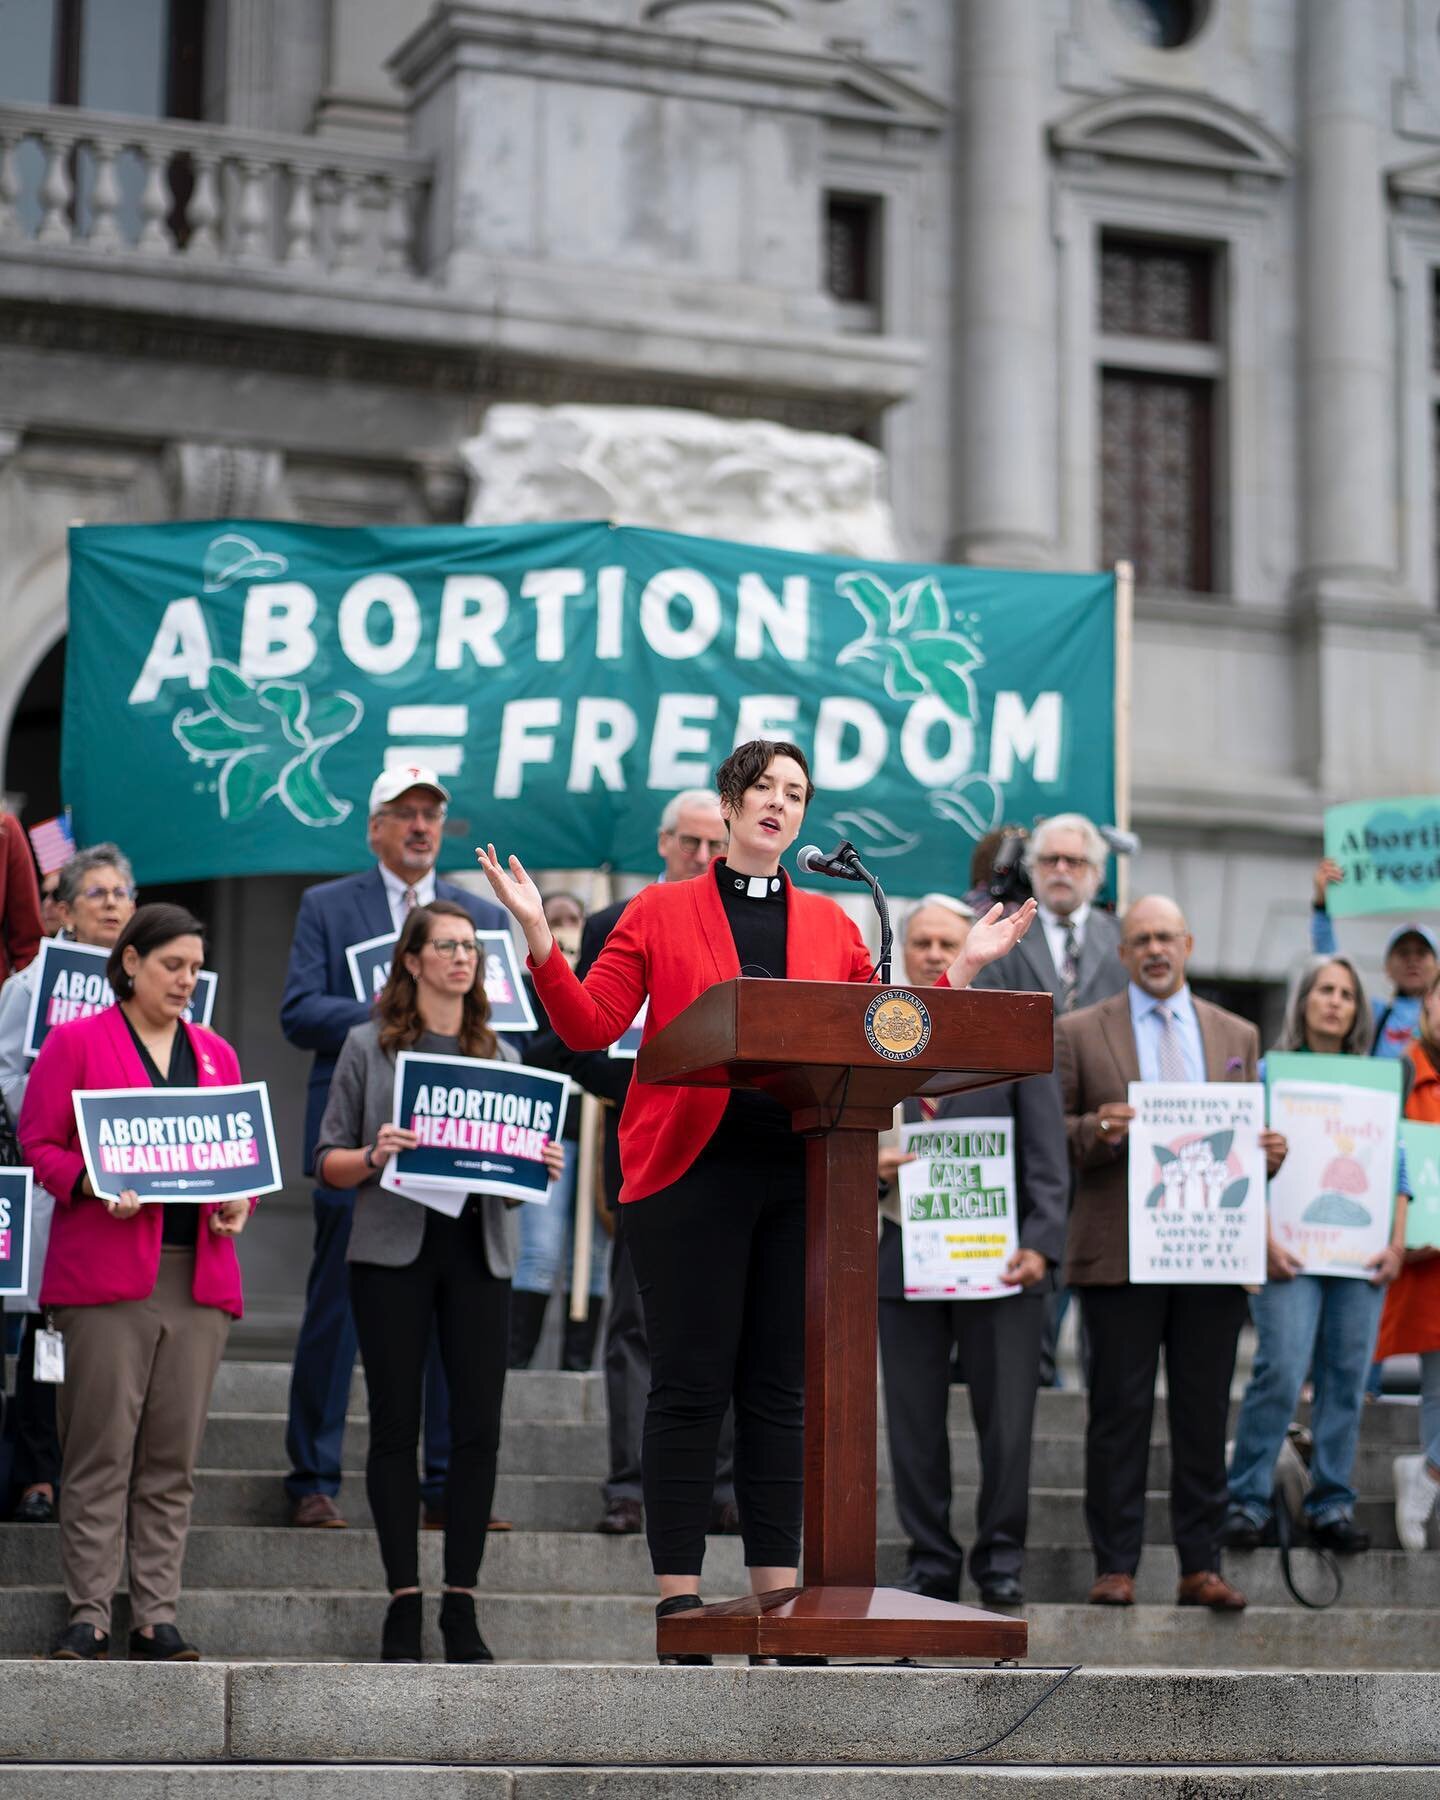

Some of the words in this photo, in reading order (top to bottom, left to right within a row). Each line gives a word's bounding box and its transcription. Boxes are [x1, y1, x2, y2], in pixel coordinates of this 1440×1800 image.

[128, 566, 809, 704] ABORTION
[868, 991, 926, 1016] PENNSYLVANIA
[866, 1025, 884, 1052] STATE
[883, 1050, 905, 1060] COAT
[905, 1048, 917, 1058] OF
[916, 1026, 930, 1052] ARMS
[413, 1084, 532, 1127] ABORTION
[533, 1100, 554, 1132] IS
[1142, 1098, 1230, 1110] ABORTION
[1237, 1098, 1253, 1110] IS
[99, 1114, 223, 1146] ABORTION
[226, 1111, 254, 1141] IS
[1142, 1113, 1197, 1126] LEGAL
[1205, 1114, 1223, 1126] IN
[1231, 1114, 1252, 1127] PA
[414, 1115, 500, 1152] HEALTH
[500, 1124, 546, 1162] CARE
[908, 1131, 1001, 1158] ABORTION
[103, 1145, 190, 1174] HEALTH
[192, 1138, 257, 1171] CARE
[931, 1163, 979, 1188] CARE
[908, 1196, 927, 1219] IS
[931, 1194, 945, 1217] A
[949, 1191, 1005, 1218] RIGHT
[1150, 1211, 1184, 1224] AND
[1156, 1226, 1210, 1239] GOING
[1219, 1226, 1240, 1239] TO
[1162, 1241, 1209, 1254] KEEP
[1216, 1241, 1233, 1254] IT
[1150, 1256, 1195, 1269] THAT
